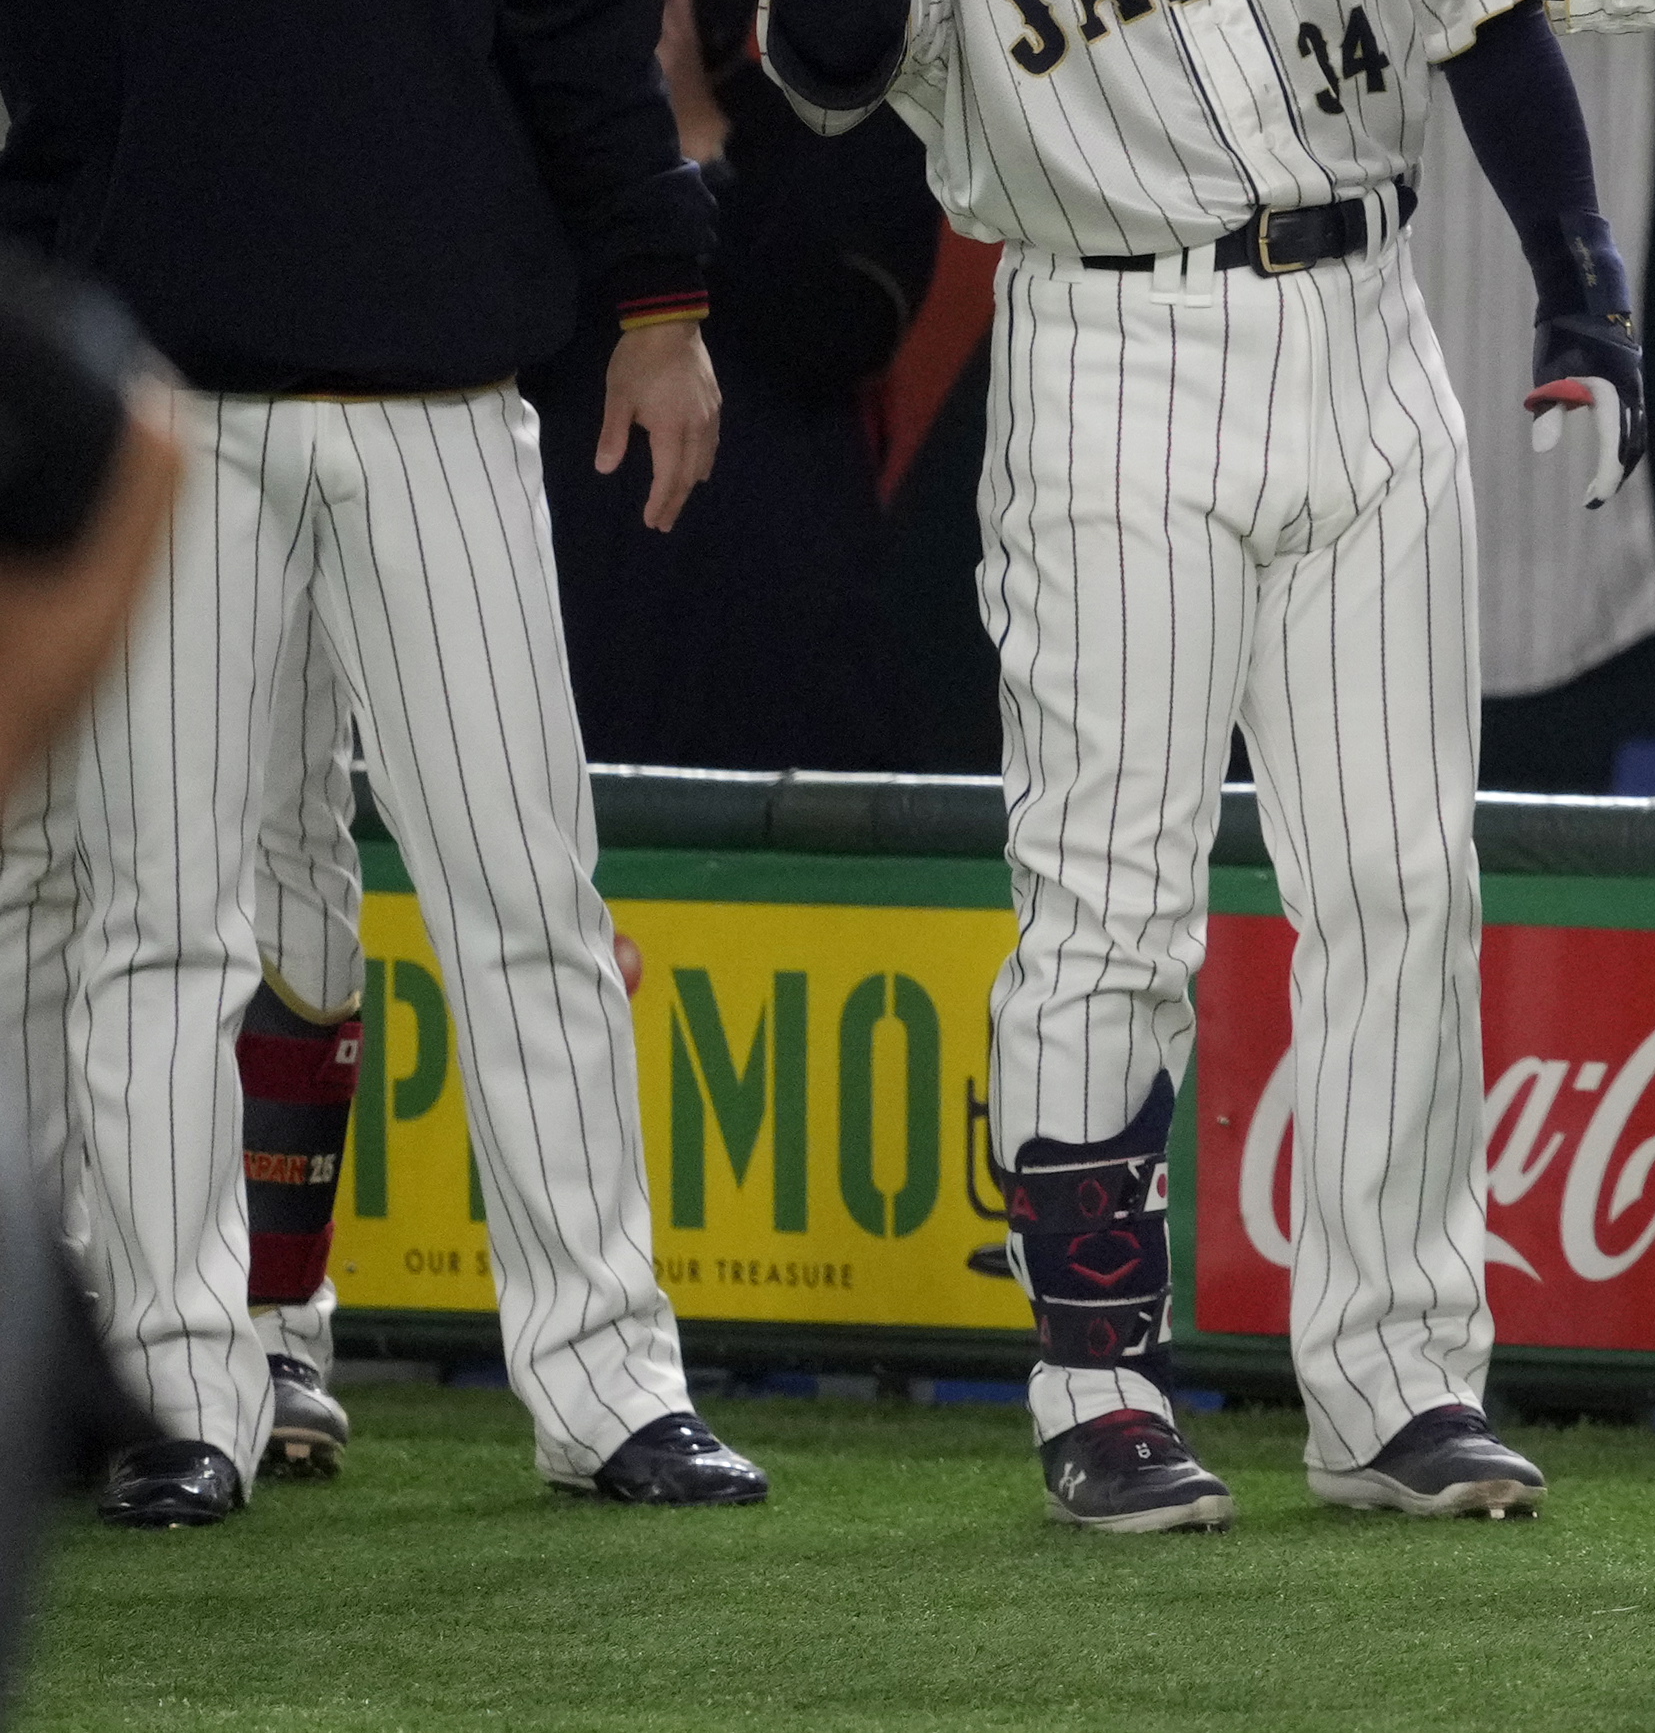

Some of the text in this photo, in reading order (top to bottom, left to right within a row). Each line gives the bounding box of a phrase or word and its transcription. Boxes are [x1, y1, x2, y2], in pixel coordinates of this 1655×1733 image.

[1296, 3, 1390, 116] 34
[404, 1247, 460, 1277] OUR
[714, 1259, 855, 1291] TREASURE
